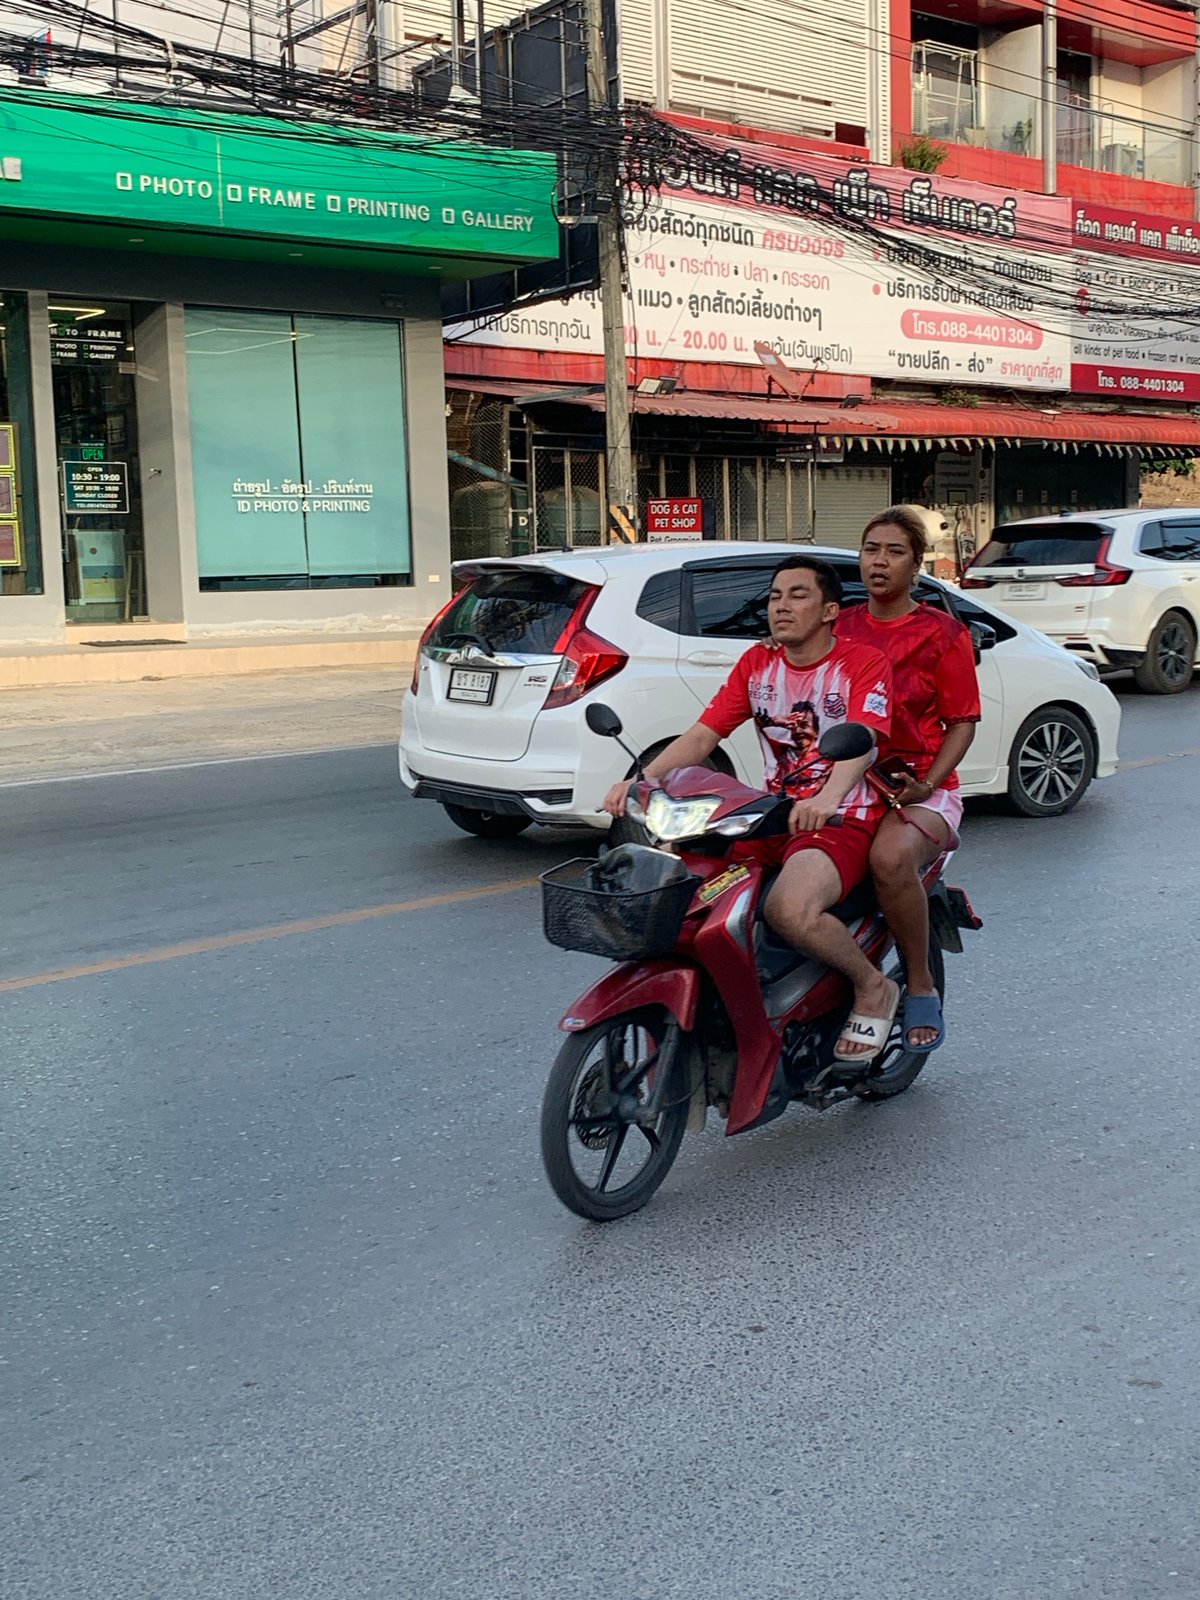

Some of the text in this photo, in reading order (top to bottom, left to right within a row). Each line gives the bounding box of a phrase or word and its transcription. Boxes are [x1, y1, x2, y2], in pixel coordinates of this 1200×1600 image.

[139, 174, 535, 233] PHOTO FRAME PRINTING GALLERY
[644, 252, 830, 291] หนู กระต่าย ปลา กระรอก
[637, 288, 673, 309] แมว
[683, 330, 727, 350] 20.00
[733, 336, 749, 352] น.
[1120, 375, 1185, 393] 088-4401304
[82, 448, 104, 460] OPEN
[71, 473, 93, 481] 10:30
[99, 474, 121, 482] 19:00
[237, 500, 371, 513] ID PHOTO & PRINTING
[650, 504, 699, 515] DOG & CAT
[654, 518, 696, 528] PET SHOP
[844, 1020, 876, 1037] FILA
